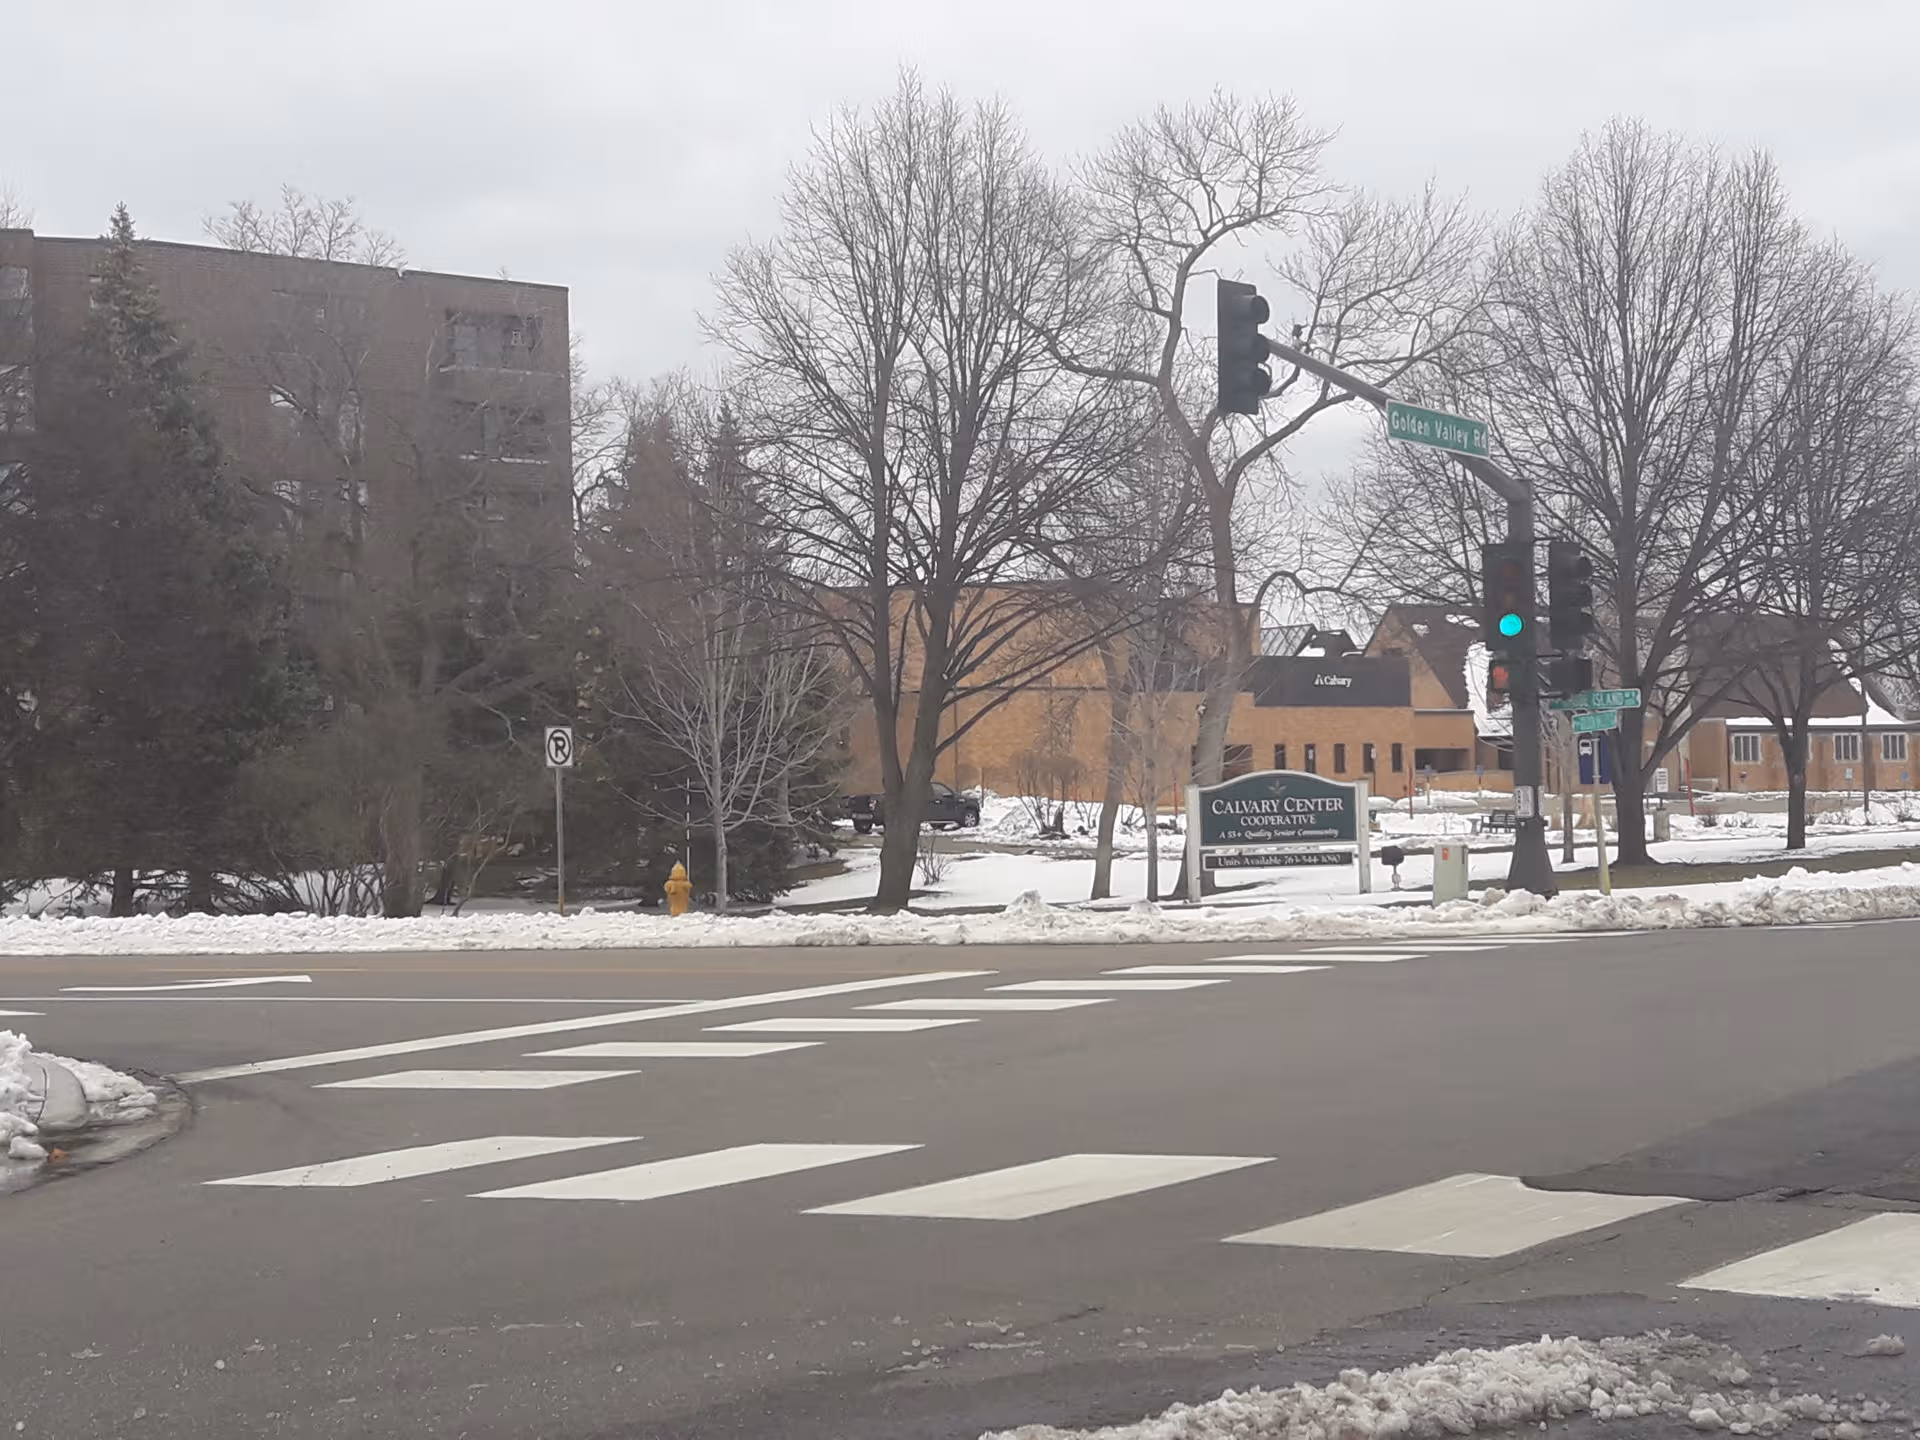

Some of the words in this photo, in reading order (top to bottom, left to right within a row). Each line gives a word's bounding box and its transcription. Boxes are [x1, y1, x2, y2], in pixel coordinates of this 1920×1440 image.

[1391, 410, 1430, 437] Golden
[1435, 420, 1469, 449] Valley
[1474, 428, 1487, 449] Rd
[1211, 799, 1280, 815] CALVARY
[1283, 797, 1344, 812] CENTER
[1240, 813, 1317, 827] COOPERATIVE
[1219, 831, 1226, 839] A
[1244, 828, 1272, 840] Quality
[1273, 828, 1296, 836] Senior
[1217, 857, 1241, 867] Units
[1243, 855, 1281, 866] Available
